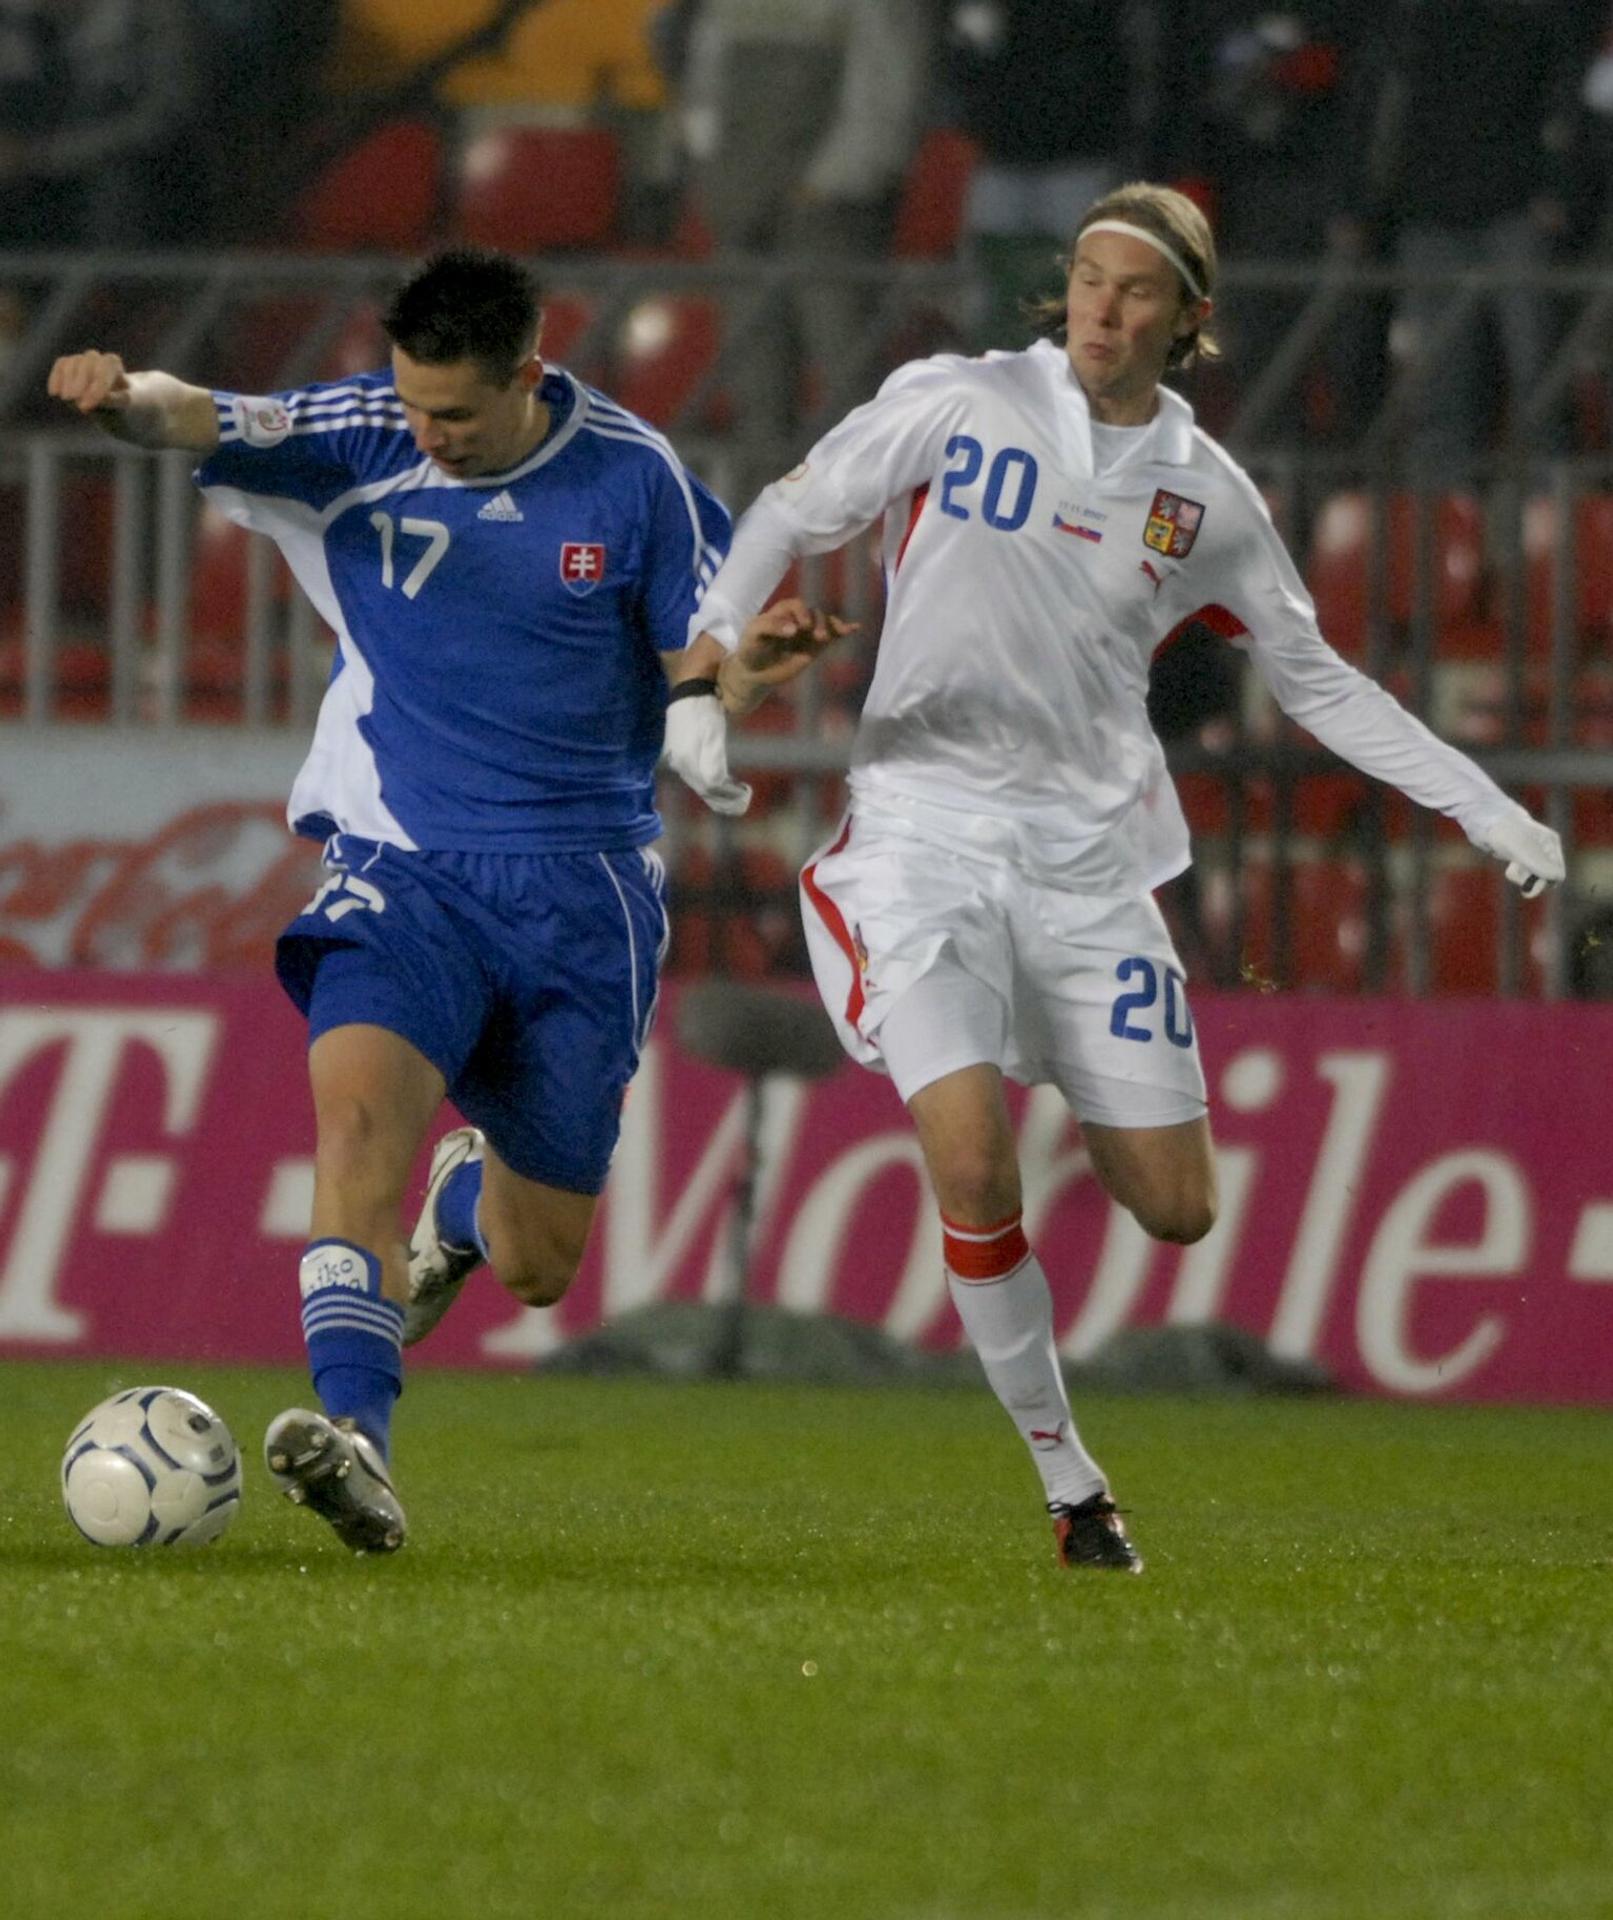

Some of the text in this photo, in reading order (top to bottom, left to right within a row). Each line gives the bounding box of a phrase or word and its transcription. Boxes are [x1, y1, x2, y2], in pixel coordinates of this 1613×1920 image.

[476, 510, 524, 522] adidas
[941, 435, 1038, 532] 20
[369, 511, 449, 600] 17
[1110, 957, 1193, 1049] 20
